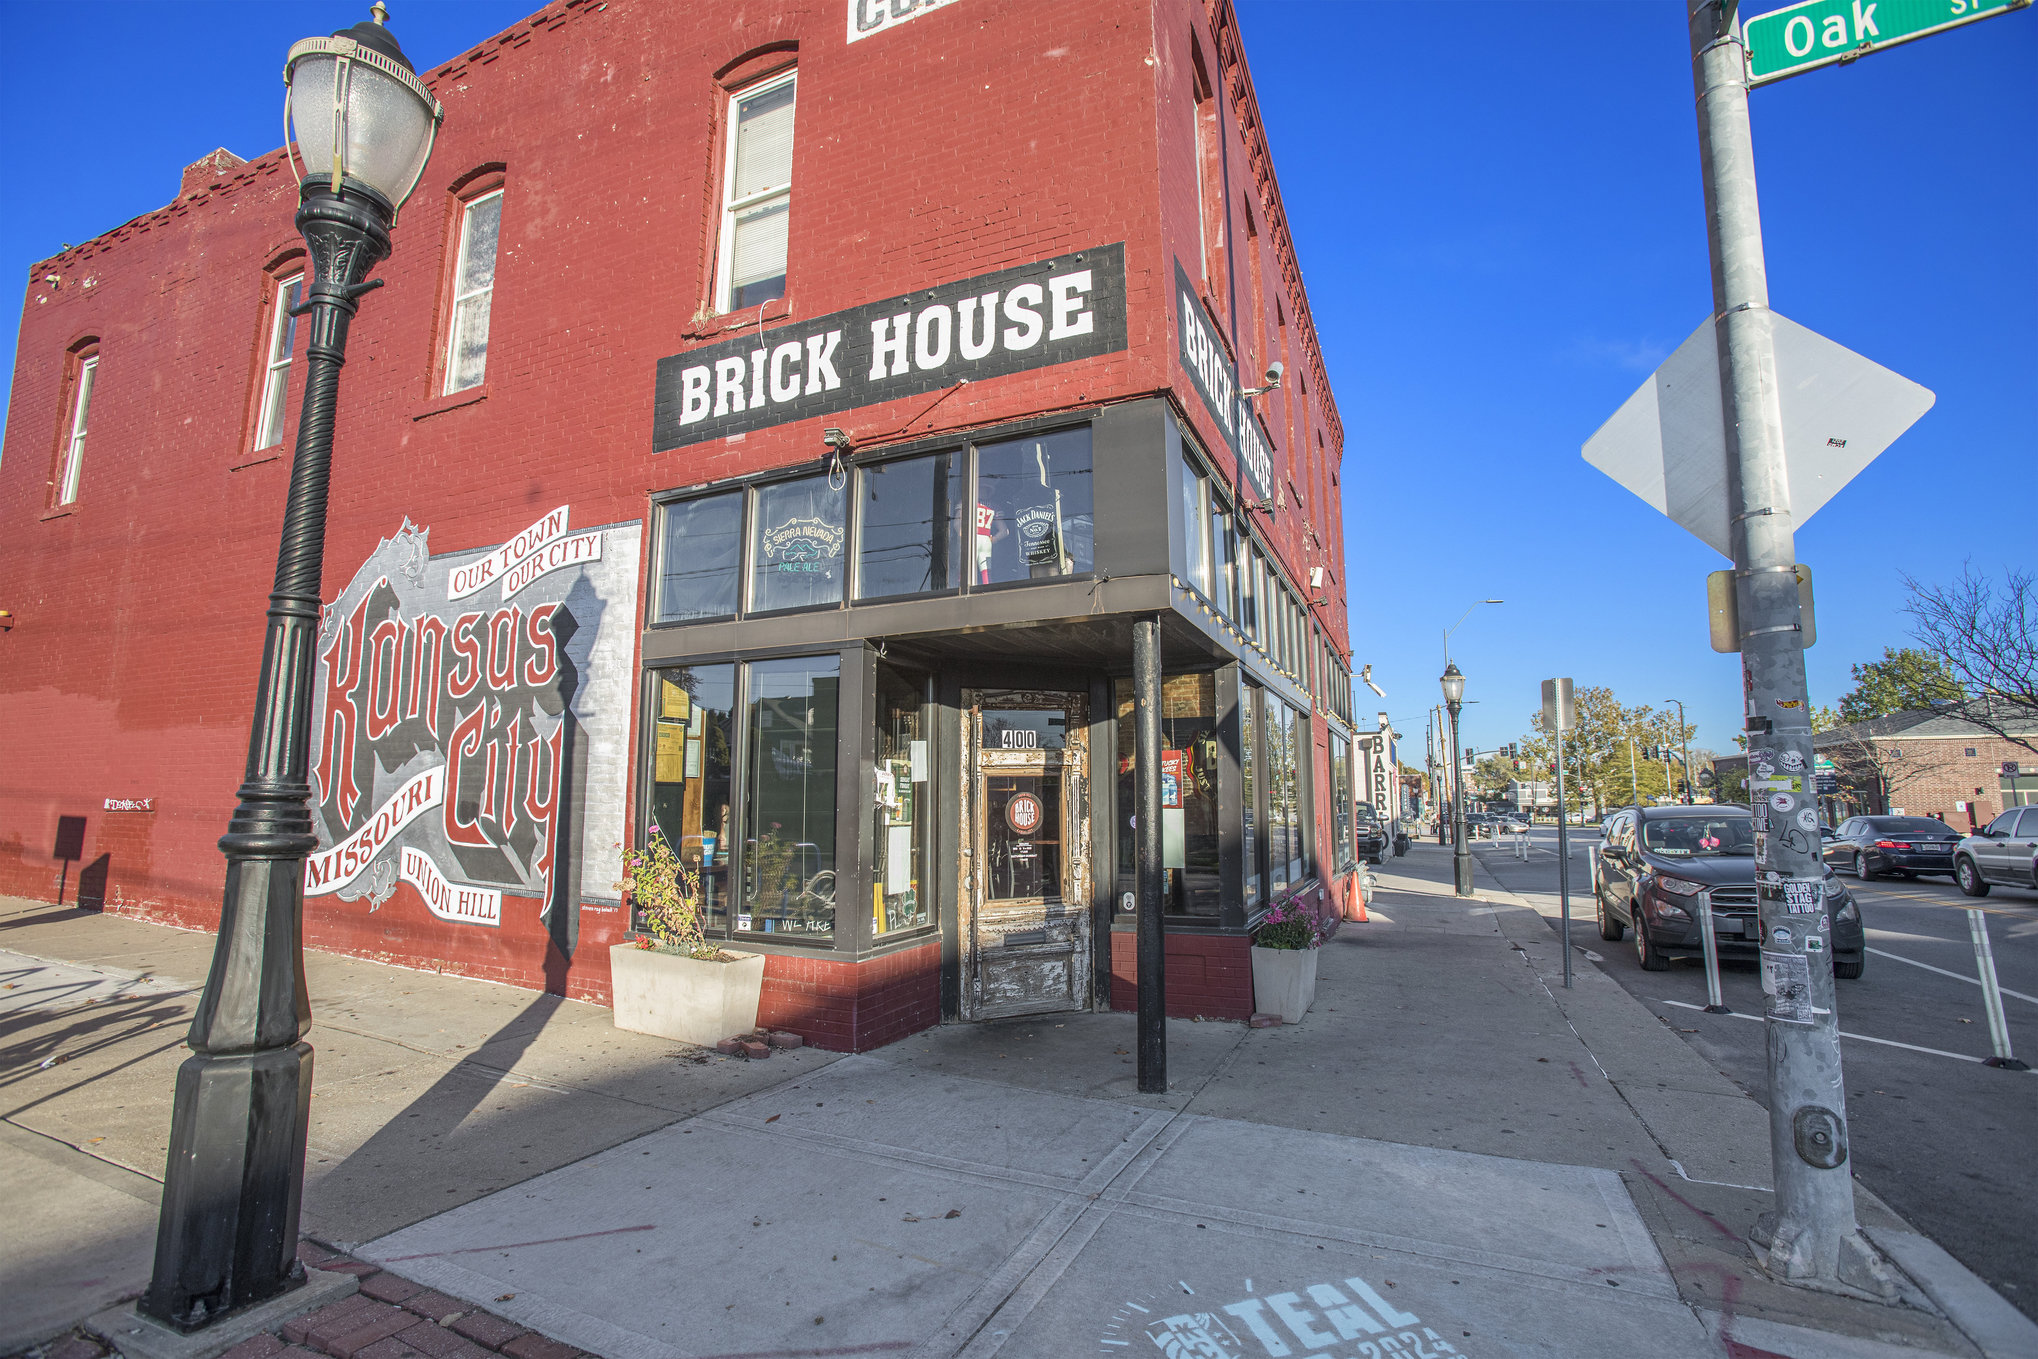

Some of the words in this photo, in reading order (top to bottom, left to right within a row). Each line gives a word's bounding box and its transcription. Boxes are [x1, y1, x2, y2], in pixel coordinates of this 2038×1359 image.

[1784, 0, 1879, 57] Oak
[679, 330, 841, 426] BRICK
[869, 269, 1094, 381] HOUSE
[1183, 291, 1233, 436] BRICK
[1238, 399, 1271, 499] HOUSE
[773, 527, 800, 544] SIERRA
[802, 526, 834, 544] NEVADA
[977, 507, 995, 529] 87
[1016, 513, 1031, 527] JACK
[454, 559, 494, 593] OUR
[500, 512, 562, 569] TOWN
[509, 553, 544, 592] OUR
[550, 536, 597, 566] CITY
[779, 562, 800, 572] PALE
[802, 562, 820, 572] ALE
[313, 575, 567, 831] Kansas
[1003, 731, 1035, 748] 400
[443, 696, 566, 918] City
[1015, 799, 1035, 813] BRICK
[1015, 812, 1035, 827] HOUSE
[307, 775, 433, 888] MISSOURI
[407, 853, 451, 913] UNION
[457, 891, 497, 919] HILL
[1783, 882, 1811, 893] GOLDEN
[1785, 893, 1813, 903] STAG
[1787, 903, 1815, 914] TATTOO
[1223, 1277, 1421, 1358] TEAL
